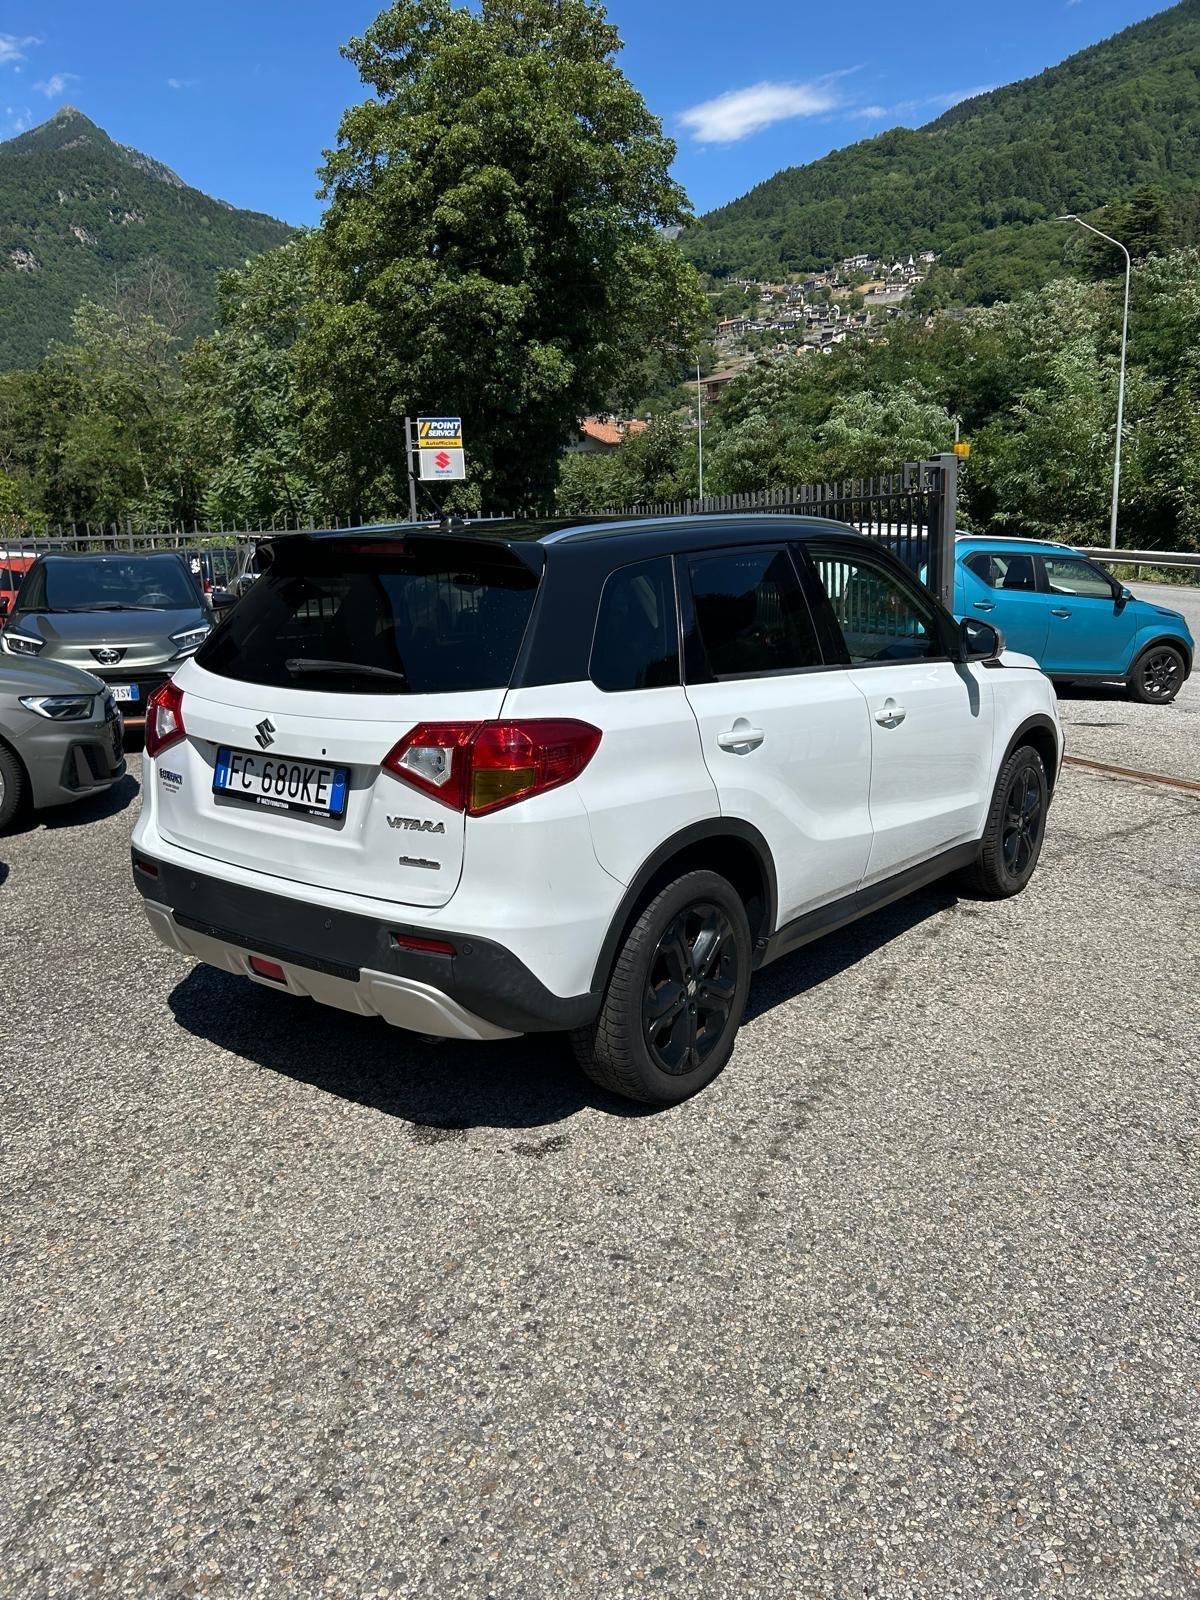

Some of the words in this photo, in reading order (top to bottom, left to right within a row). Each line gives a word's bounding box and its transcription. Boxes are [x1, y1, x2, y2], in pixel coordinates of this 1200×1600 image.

[431, 421, 460, 430] POINT
[427, 429, 456, 437] SERVICE
[228, 755, 255, 789] FC
[261, 761, 331, 806] 680KE
[386, 815, 446, 834] VITARA
